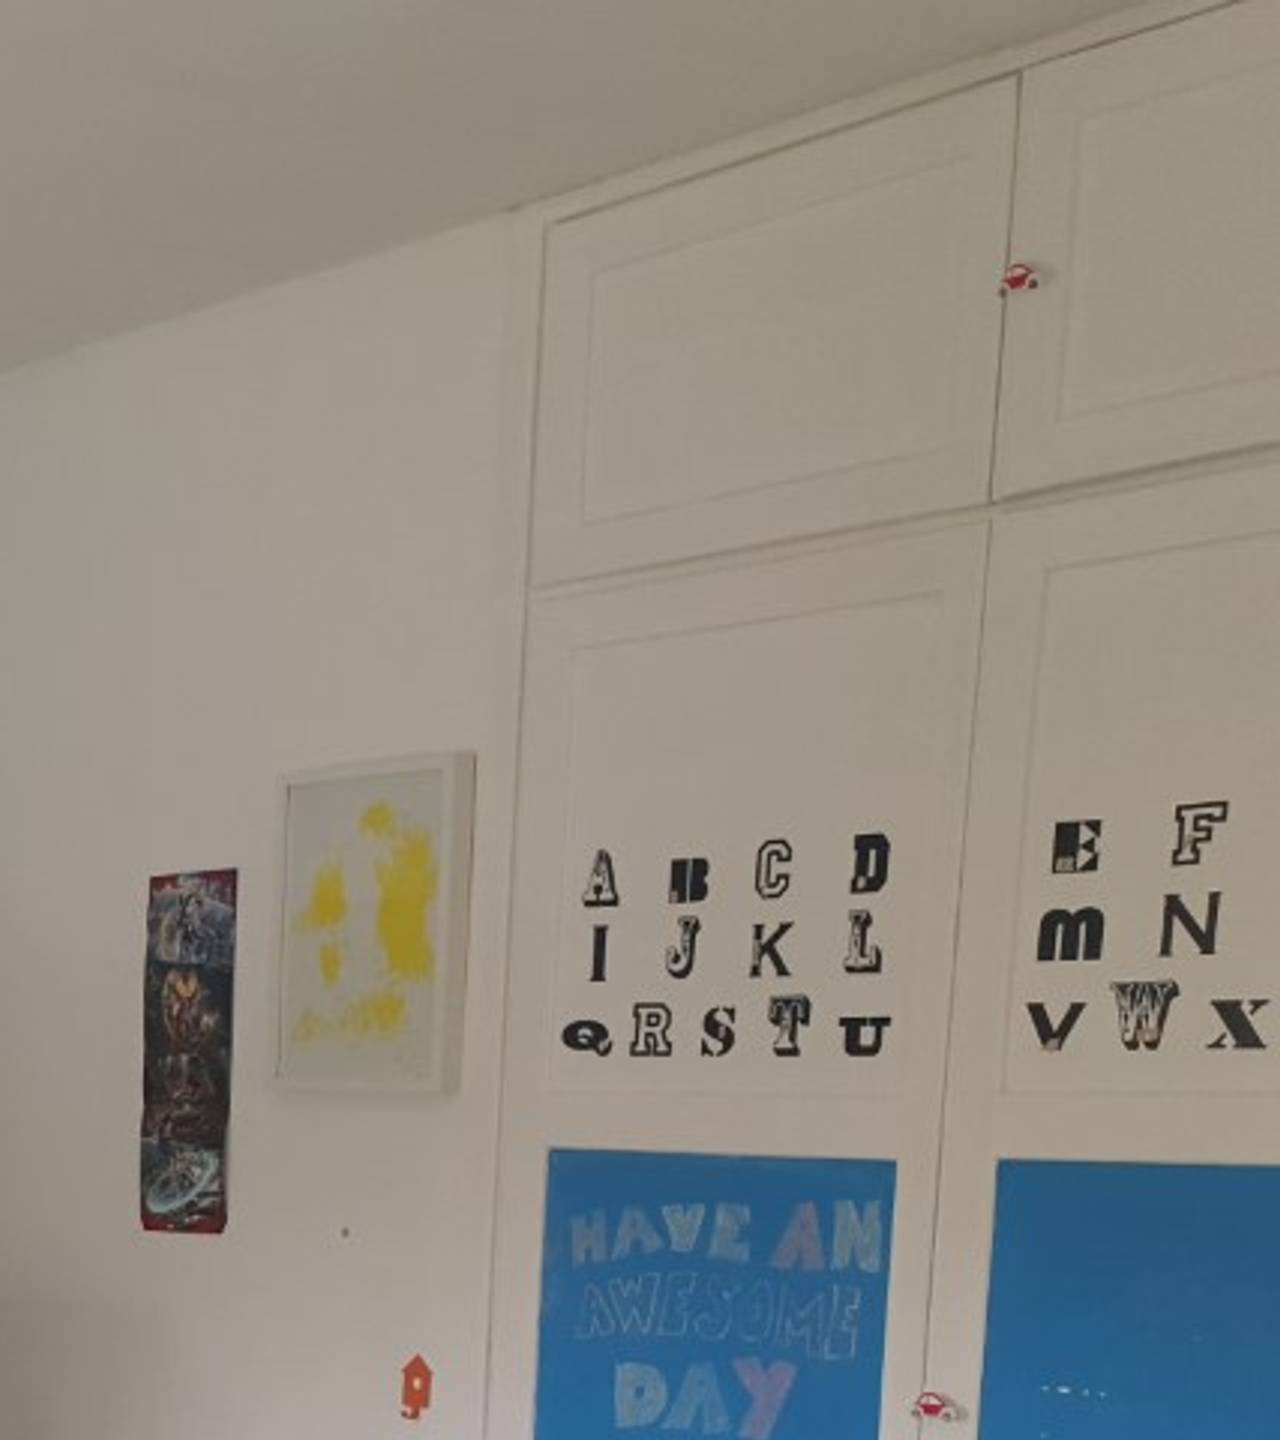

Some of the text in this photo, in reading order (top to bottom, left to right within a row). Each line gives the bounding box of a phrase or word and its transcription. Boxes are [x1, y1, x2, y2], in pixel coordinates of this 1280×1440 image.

[582, 832, 891, 908] A B C D
[1051, 800, 1229, 875] E F
[666, 916, 701, 979] J
[749, 921, 794, 979] K
[842, 909, 882, 974] L
[1159, 891, 1222, 958] N
[629, 1002, 672, 1057] R
[700, 1005, 737, 1058] S
[768, 994, 812, 1057] T
[838, 1016, 892, 1058] U
[1025, 979, 1271, 1053] V W X
[570, 1199, 883, 1273] HAVE AN
[574, 1271, 861, 1360] AWESOME
